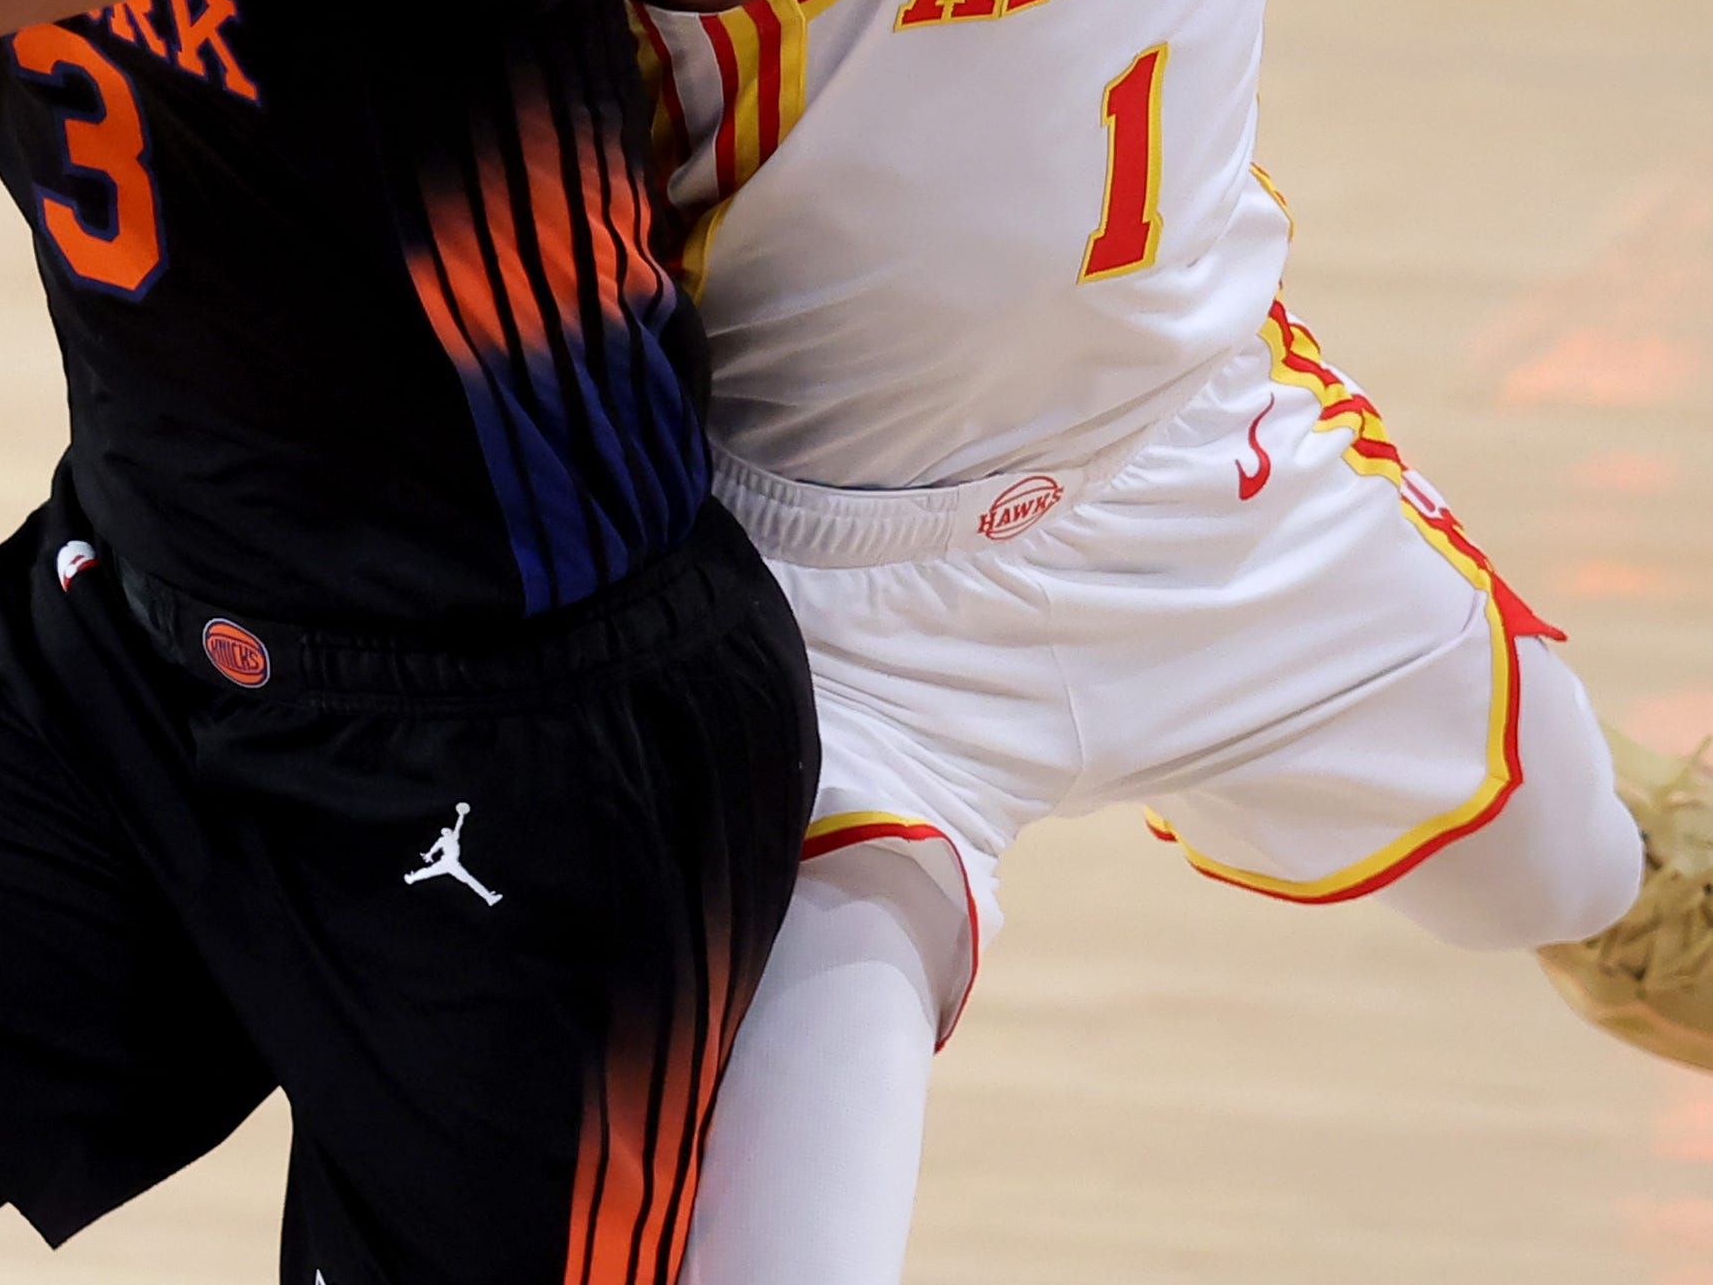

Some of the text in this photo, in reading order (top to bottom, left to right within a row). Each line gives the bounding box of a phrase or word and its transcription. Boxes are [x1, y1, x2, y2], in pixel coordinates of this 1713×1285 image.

[8, 22, 168, 303] 3
[1076, 42, 1169, 285] 1
[976, 486, 1064, 534] HAWKS
[209, 637, 261, 672] KNICKS
